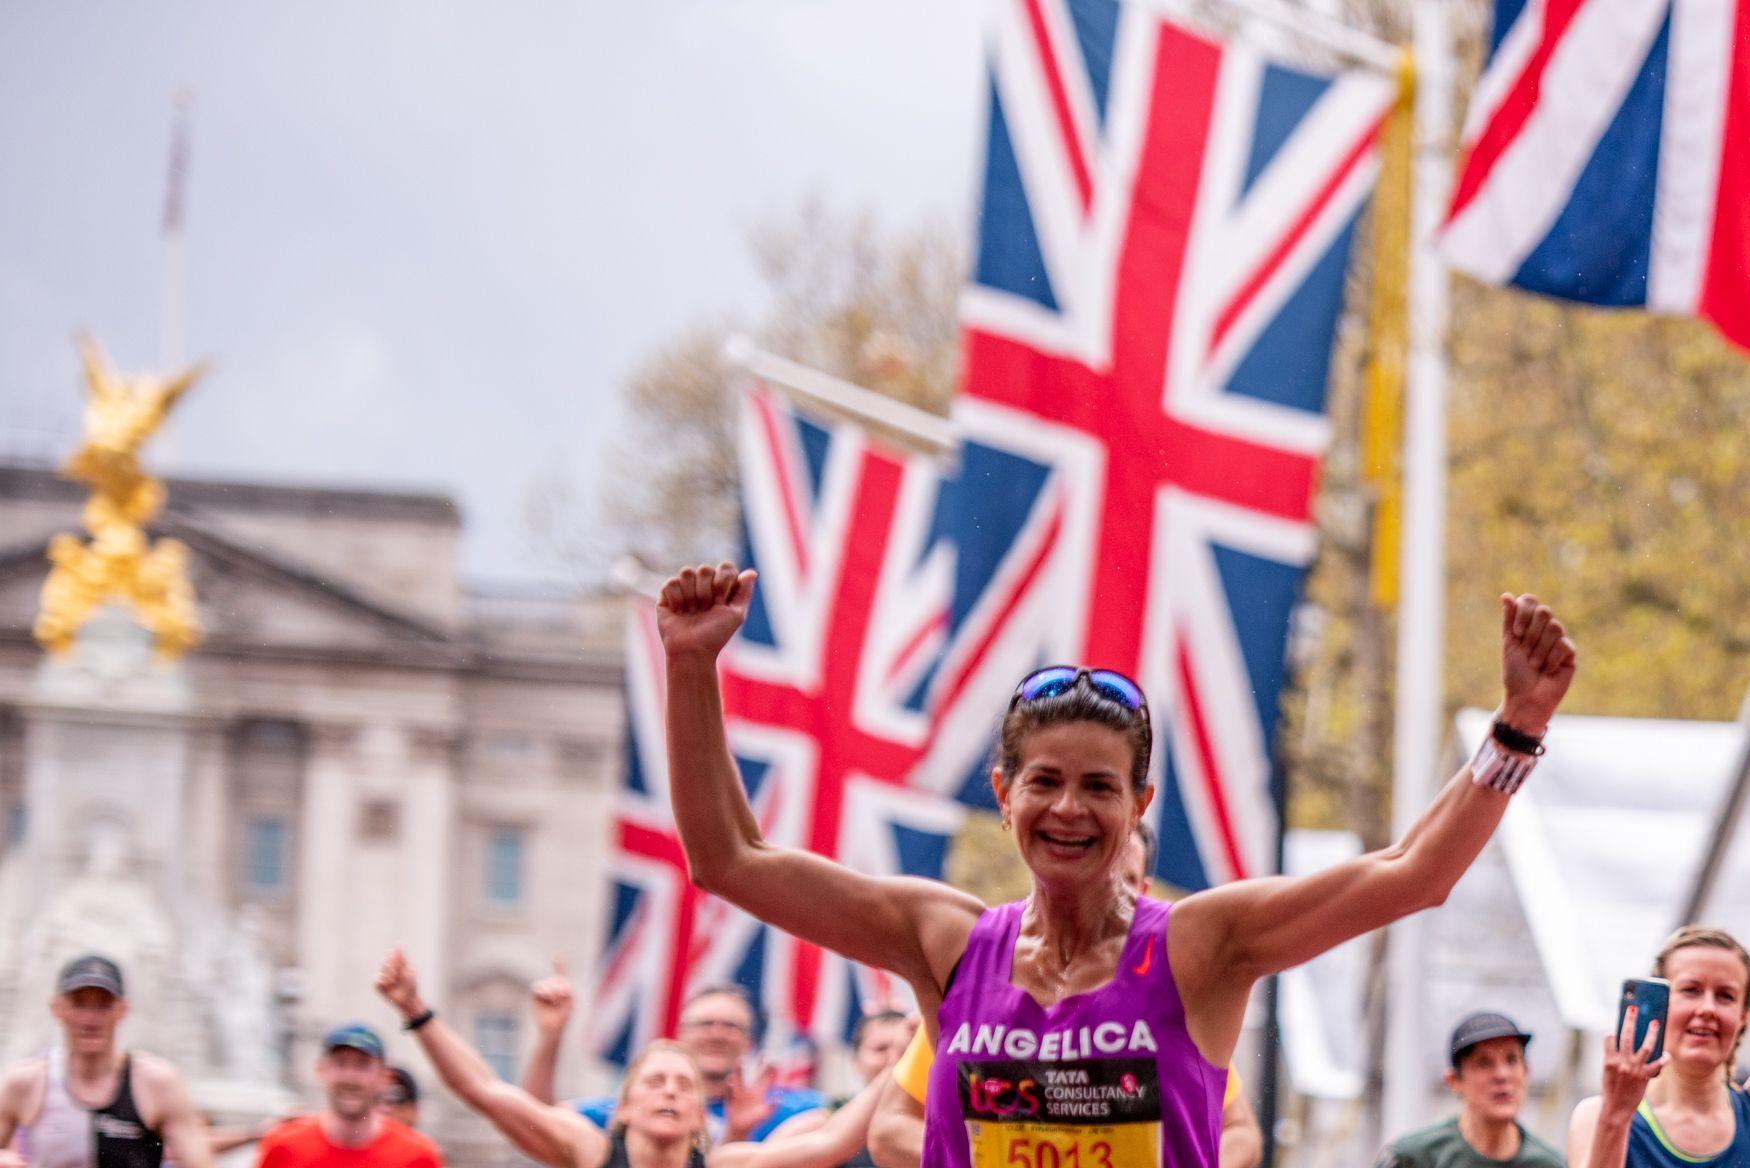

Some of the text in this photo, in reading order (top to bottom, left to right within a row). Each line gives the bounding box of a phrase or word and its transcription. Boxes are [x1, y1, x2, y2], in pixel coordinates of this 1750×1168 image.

[947, 1020, 1158, 1062] ANGELICA
[1045, 1070, 1089, 1085] TATA
[970, 1073, 1039, 1115] tcs
[1046, 1101, 1111, 1117] SERVICES
